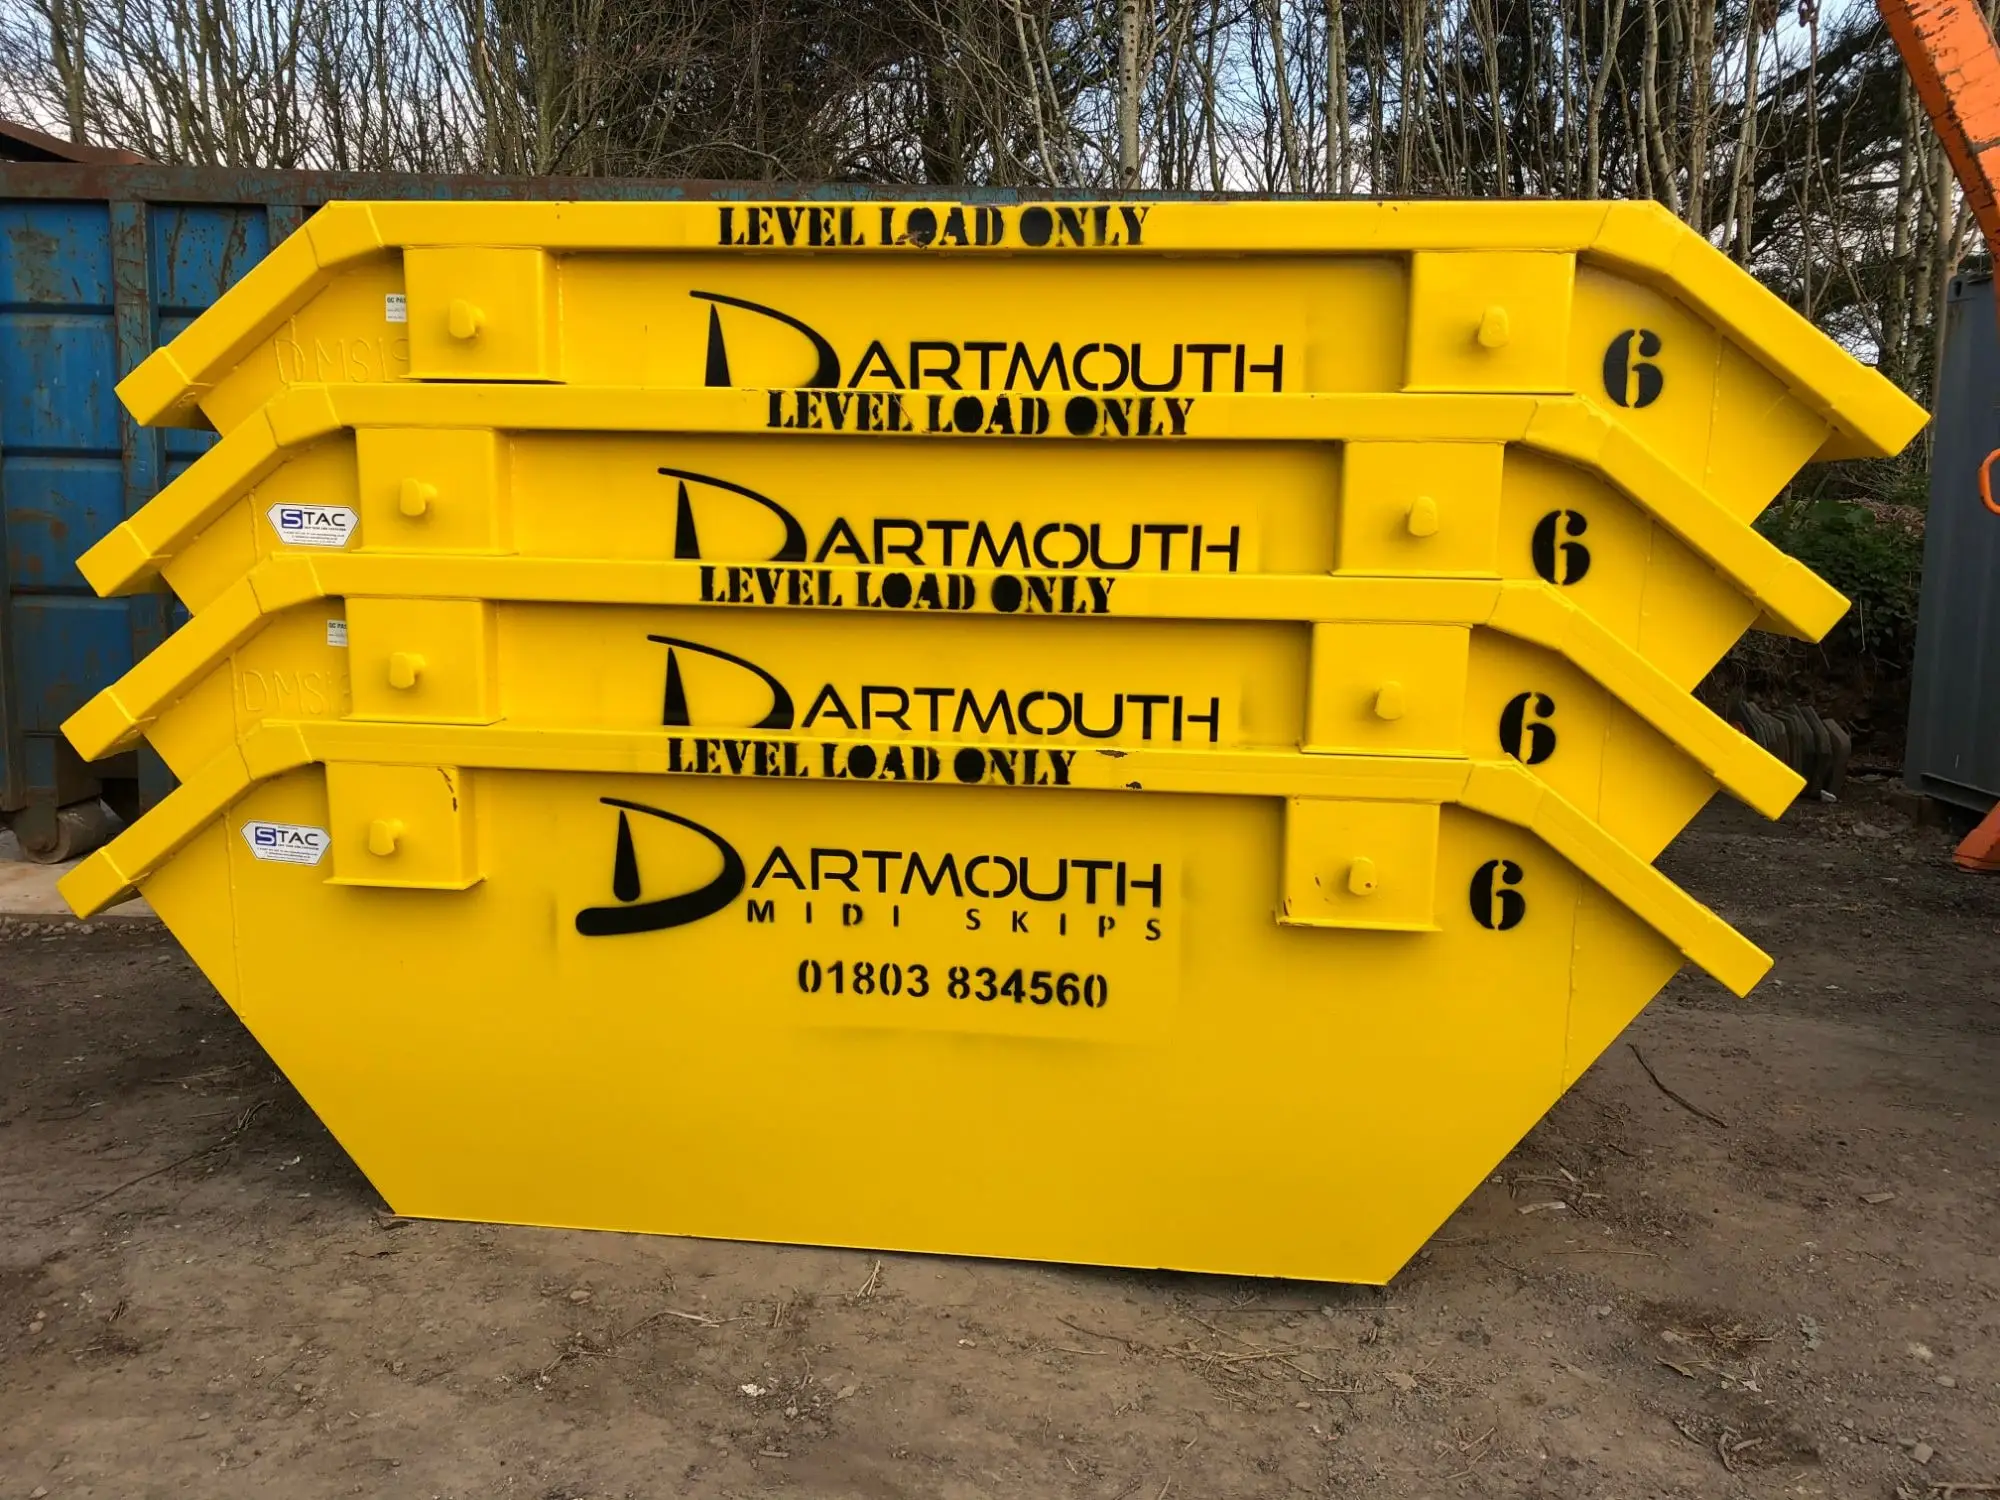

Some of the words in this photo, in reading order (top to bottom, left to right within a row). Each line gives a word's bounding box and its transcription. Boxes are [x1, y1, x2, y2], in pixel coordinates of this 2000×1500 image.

[718, 206, 865, 246] LEVEL
[880, 206, 1003, 249] LOAD
[1018, 206, 1151, 247] ONLY
[690, 291, 1284, 392] DARTMOUTH
[1603, 330, 1664, 408] 6
[767, 390, 913, 431] LEVEL
[926, 394, 1050, 434] LOAD
[1065, 396, 1195, 437] ONLY
[281, 508, 346, 529] STAC
[658, 468, 1239, 571] DARTMOUTH
[1532, 510, 1591, 585] 6
[700, 565, 843, 606] LEVEL
[856, 570, 976, 610] LOAD
[990, 573, 1116, 614] ONLY
[647, 635, 1219, 743] DARTMOUTH
[1500, 692, 1557, 764] 6
[668, 737, 808, 778] LEVEL
[822, 743, 940, 782] LOAD
[953, 747, 1077, 786] ONLY
[255, 826, 319, 847] STAC
[576, 797, 1162, 936] DARTMOUTH
[1470, 860, 1526, 930] 6
[747, 899, 900, 927] MIDI
[965, 908, 1162, 941] SKIPS
[799, 960, 930, 997] 01803
[947, 966, 1108, 1008] 834560
